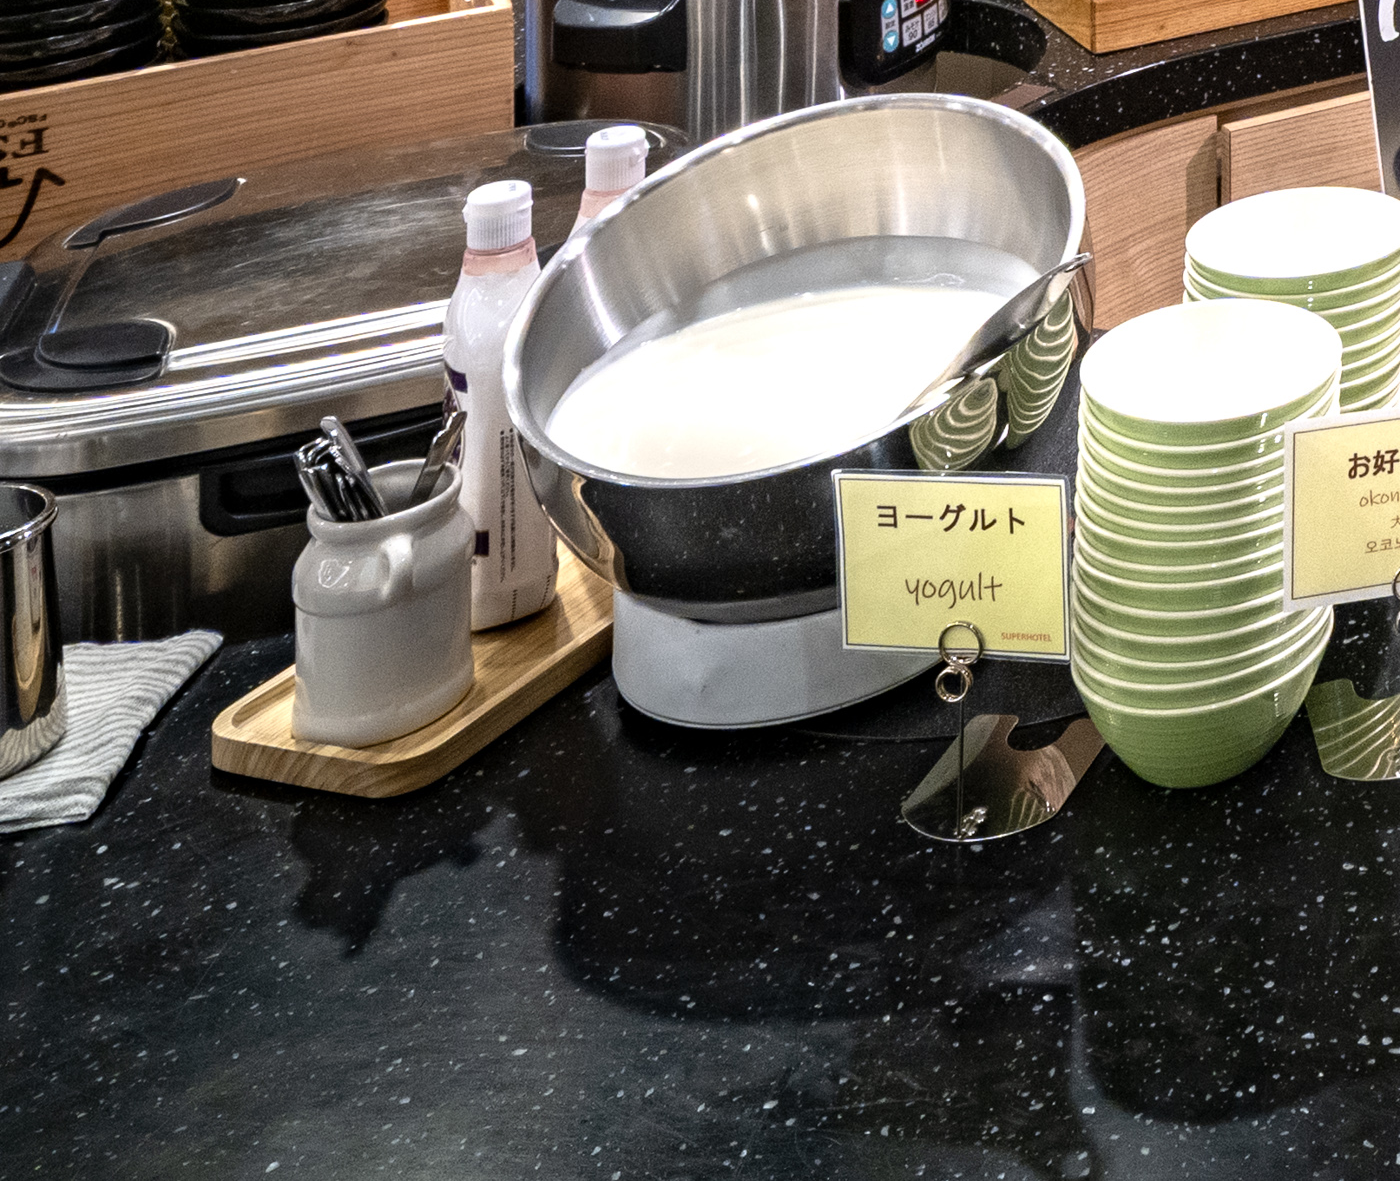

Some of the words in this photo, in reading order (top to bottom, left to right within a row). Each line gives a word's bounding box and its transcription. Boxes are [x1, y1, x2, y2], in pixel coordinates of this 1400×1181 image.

[876, 503, 1025, 535] ヨーグルト
[904, 571, 1003, 610] yogult
[1000, 631, 1053, 643] SUPERHOTEL
